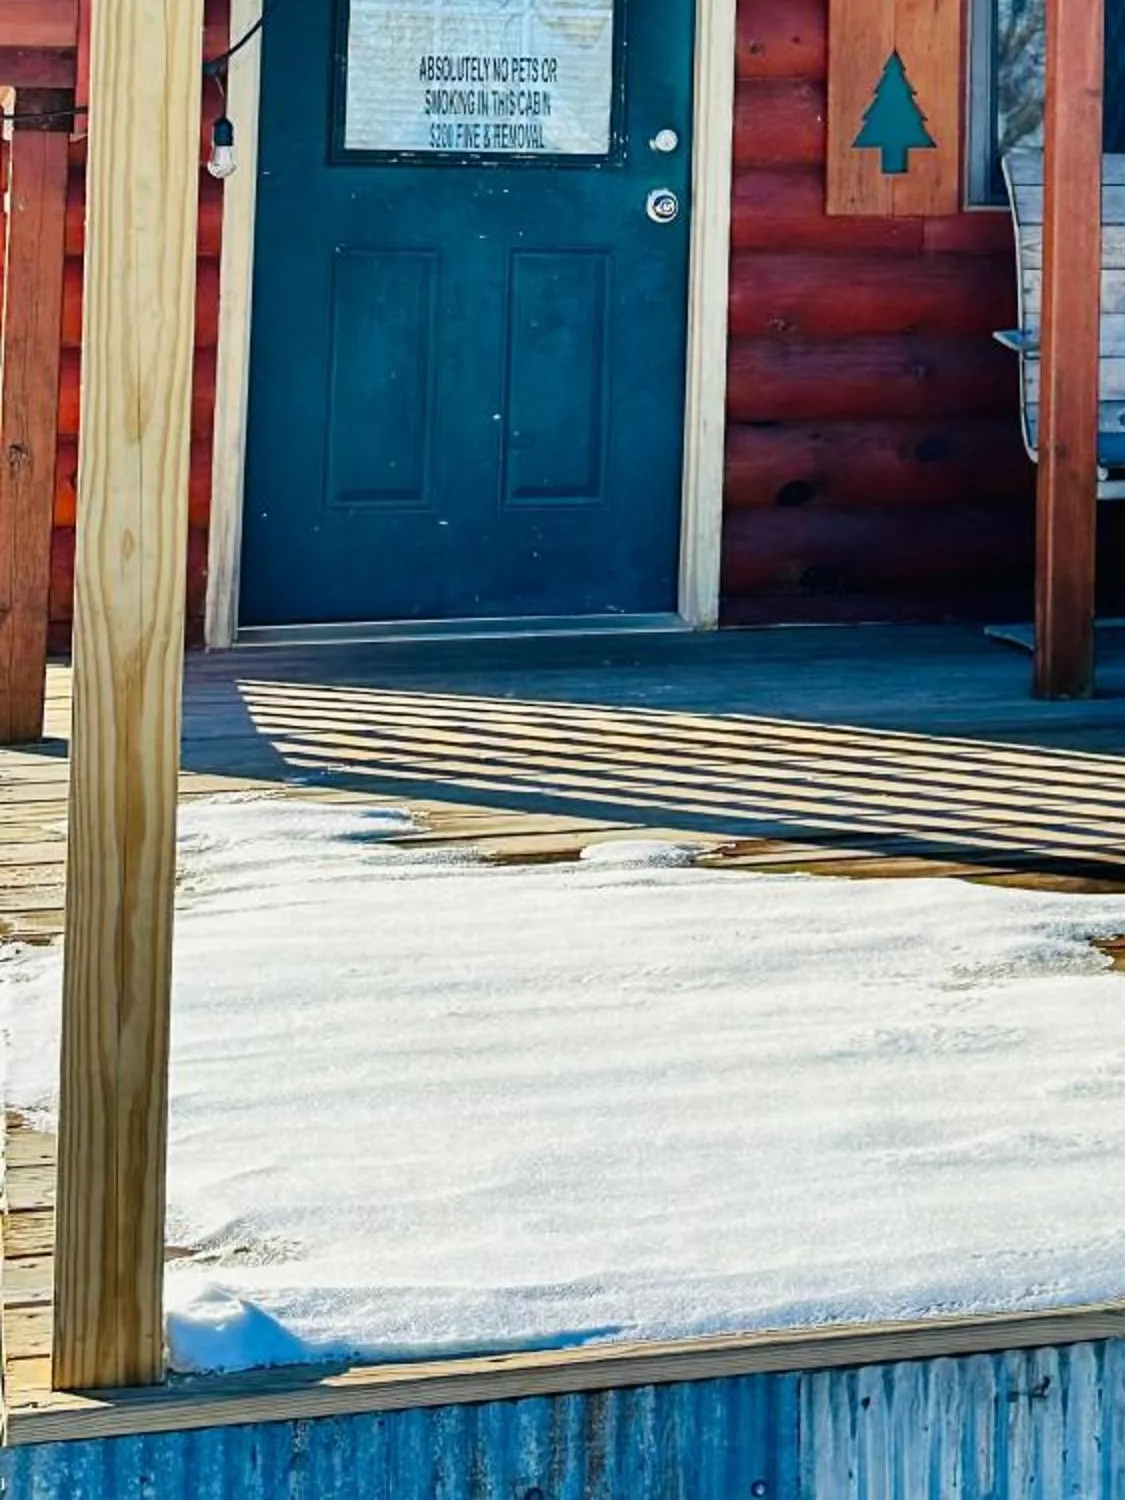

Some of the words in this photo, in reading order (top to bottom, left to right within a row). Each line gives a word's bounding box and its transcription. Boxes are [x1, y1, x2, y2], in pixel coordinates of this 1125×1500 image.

[419, 55, 490, 81] ABSOLUTELY
[493, 57, 509, 82] NO
[511, 57, 539, 82] PETS
[541, 57, 557, 82] OR
[491, 90, 517, 116] THIS
